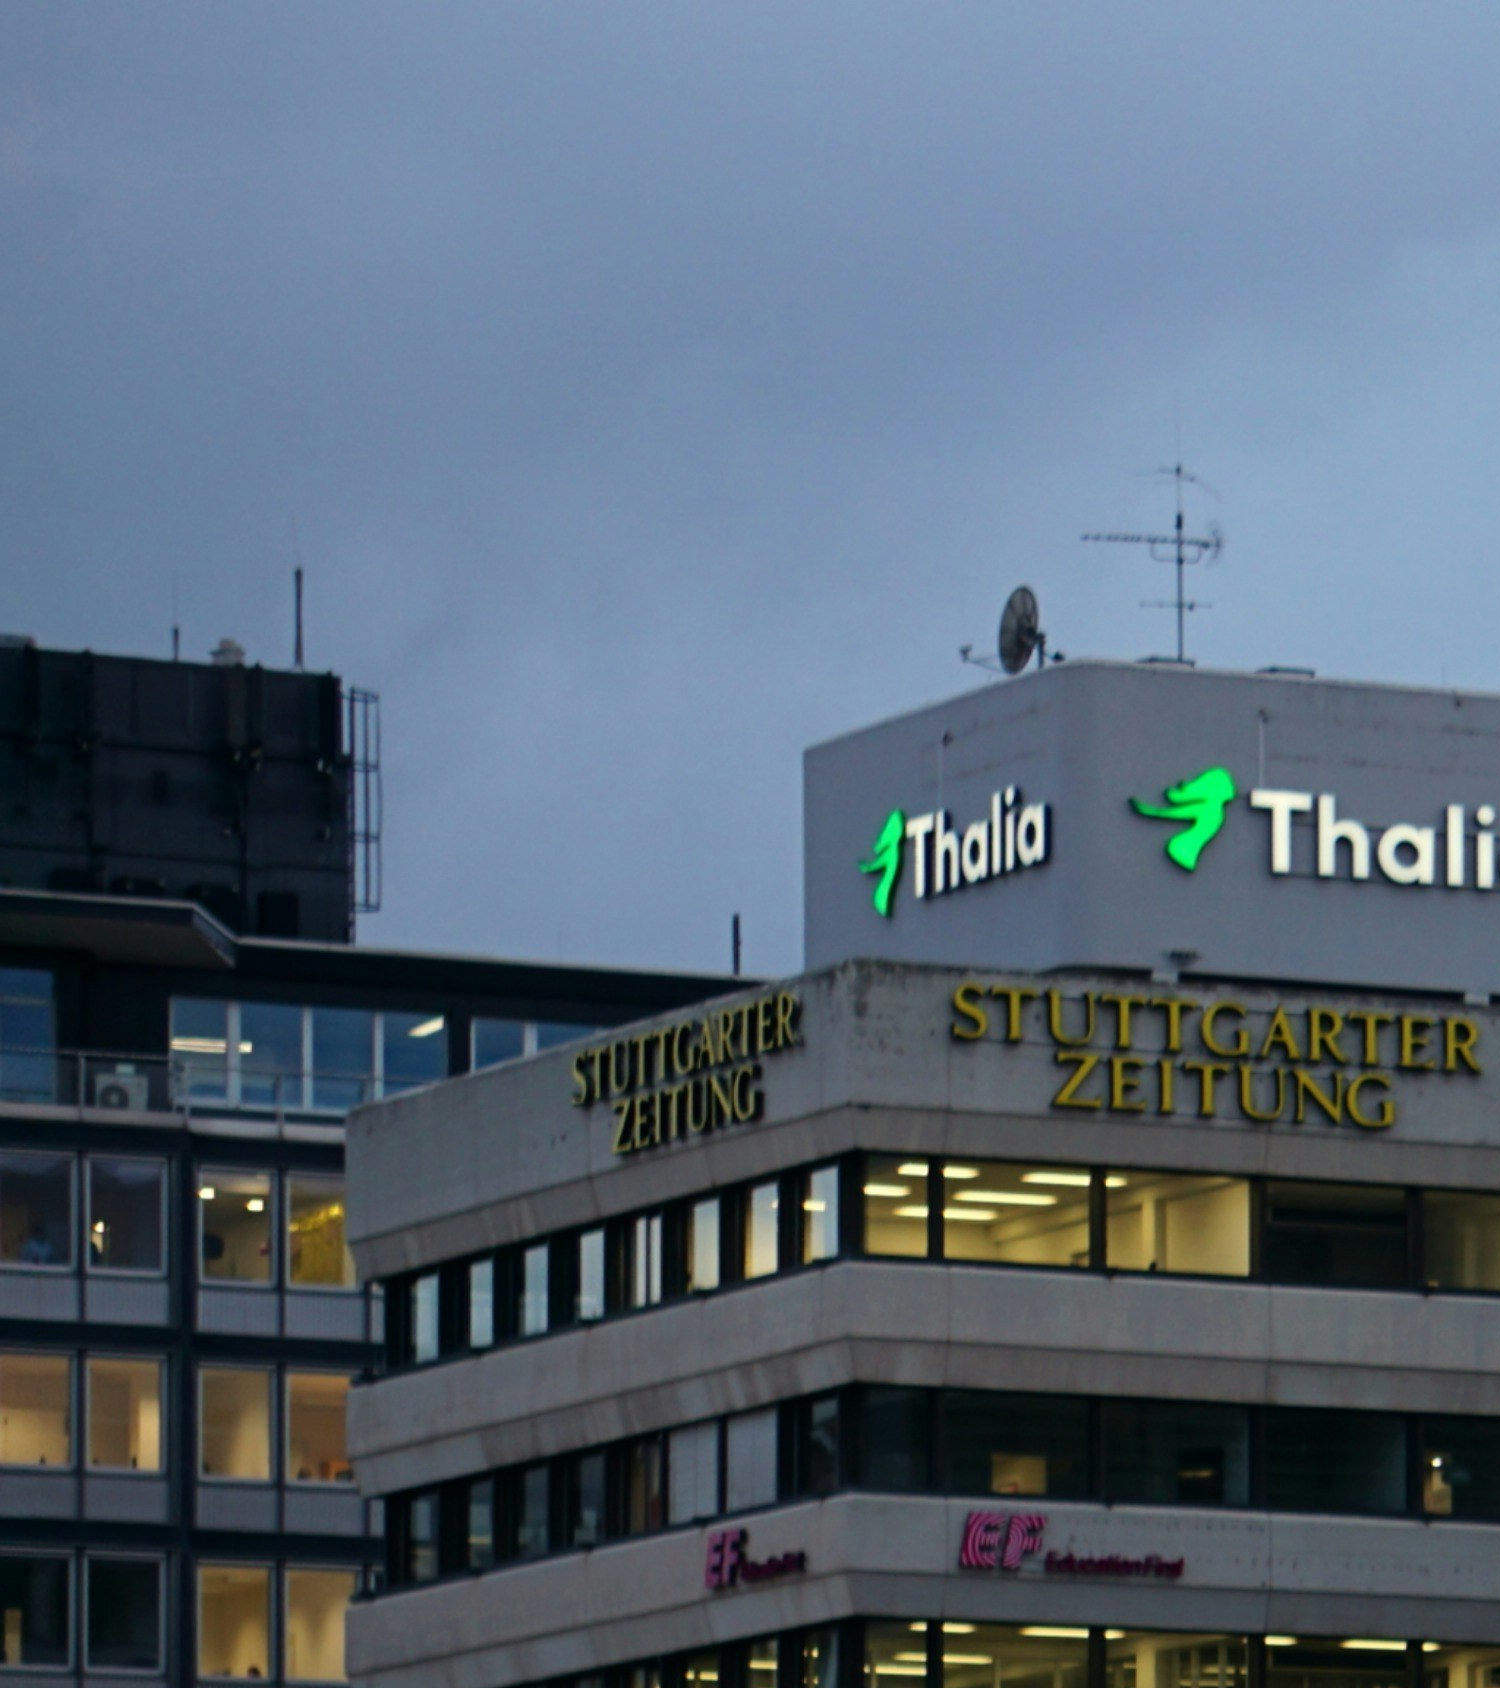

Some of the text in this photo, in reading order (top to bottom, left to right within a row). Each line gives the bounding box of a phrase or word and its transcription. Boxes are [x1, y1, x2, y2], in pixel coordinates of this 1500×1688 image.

[906, 787, 1046, 899] Thalia
[571, 993, 803, 1107] STUTTGARTER
[951, 983, 1481, 1075] STUTTGARTER
[611, 1068, 763, 1154] ZEITUNG
[1053, 1051, 1396, 1129] ZEITUNG
[706, 1530, 741, 1589] EF
[959, 1511, 1047, 1570] EF
